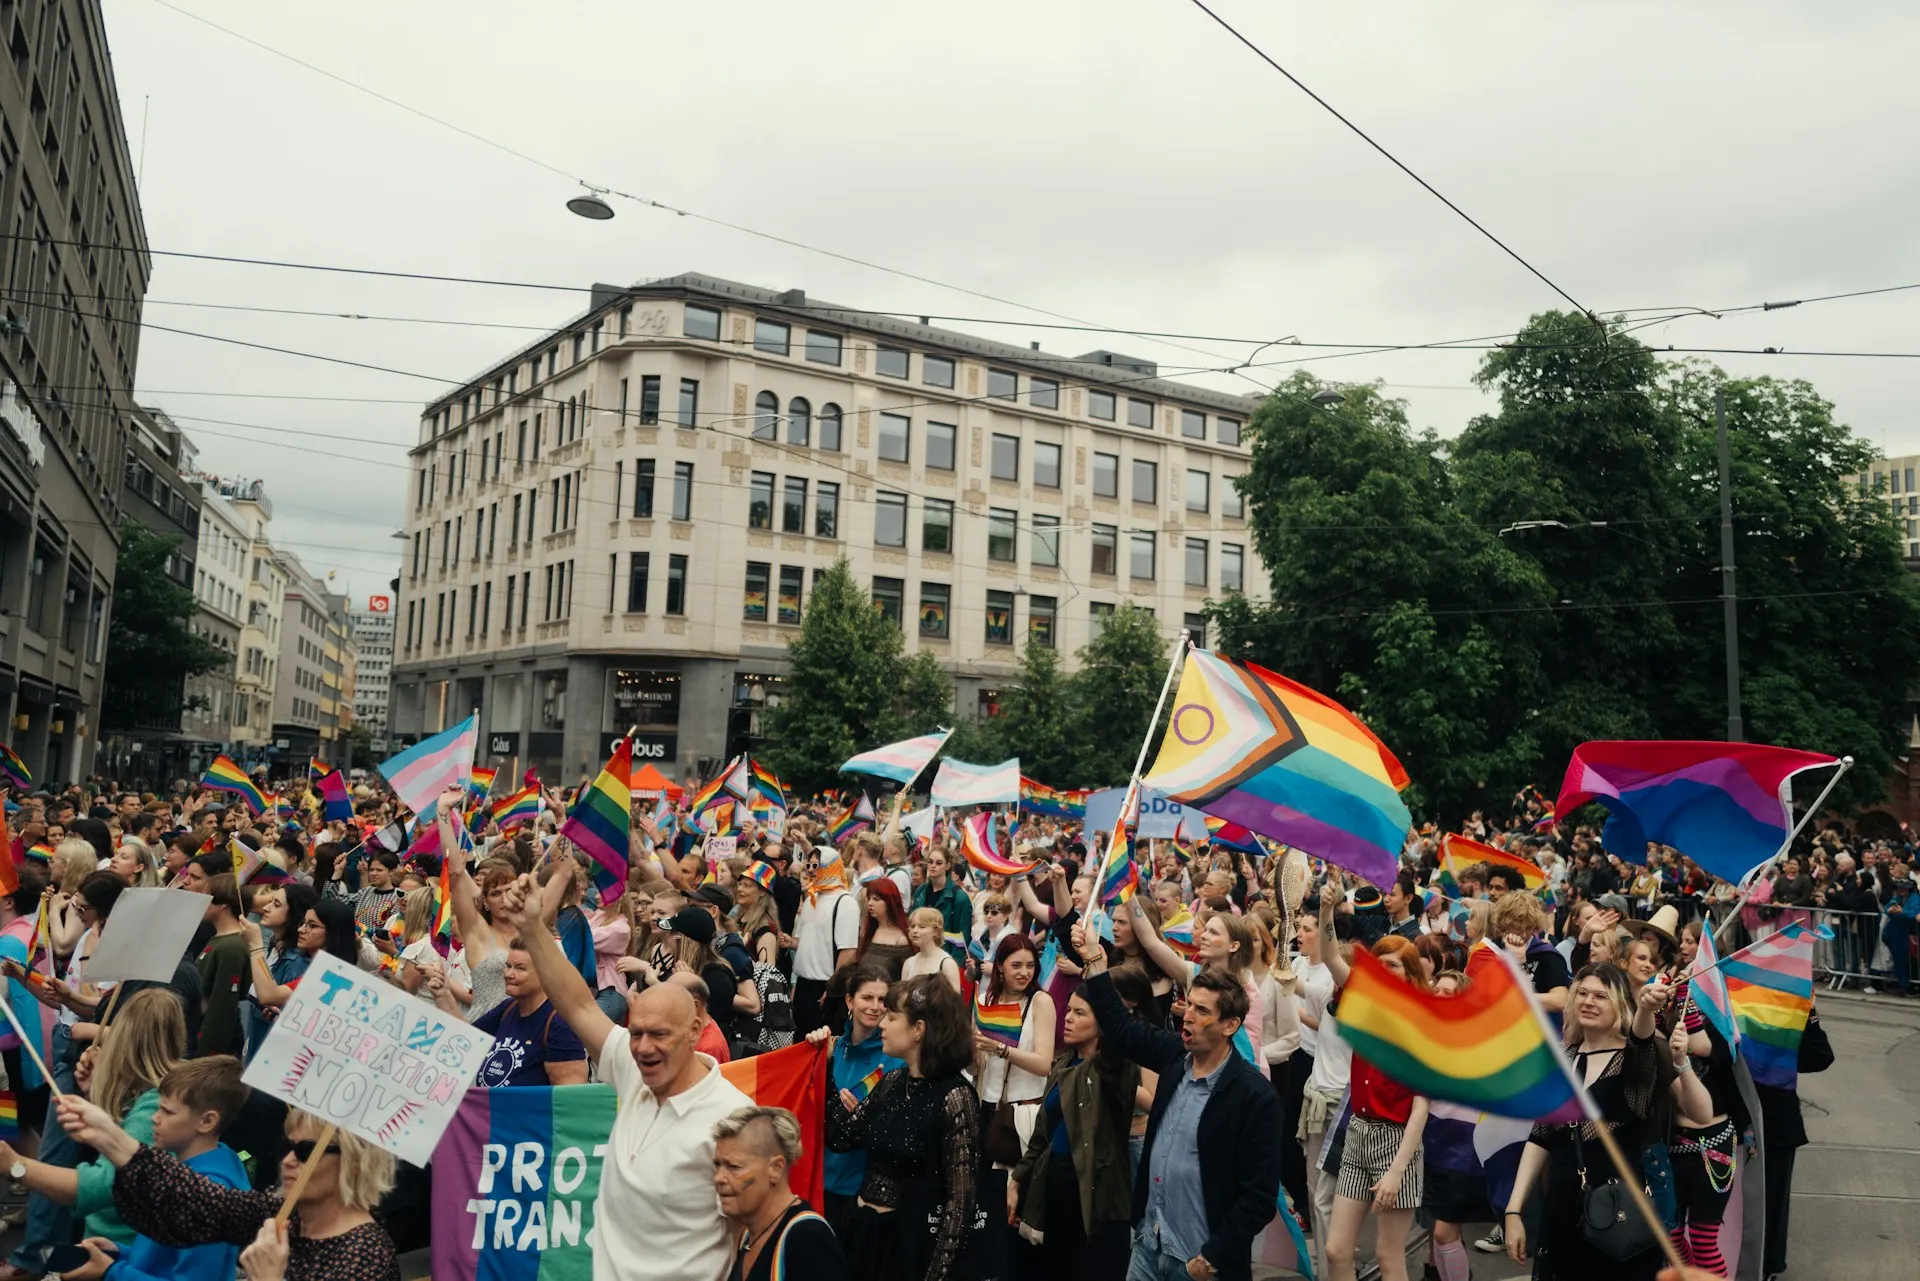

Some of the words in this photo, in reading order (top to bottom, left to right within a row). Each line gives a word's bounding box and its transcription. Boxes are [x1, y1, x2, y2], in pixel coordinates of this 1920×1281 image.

[610, 738, 665, 758] Cbus
[1120, 797, 1182, 814] oDa
[318, 969, 471, 1068] TRANS
[280, 999, 459, 1106] LIBERATION
[290, 1054, 410, 1134] NOW
[478, 1142, 609, 1195] PRO
[466, 1198, 596, 1252] TRAN
